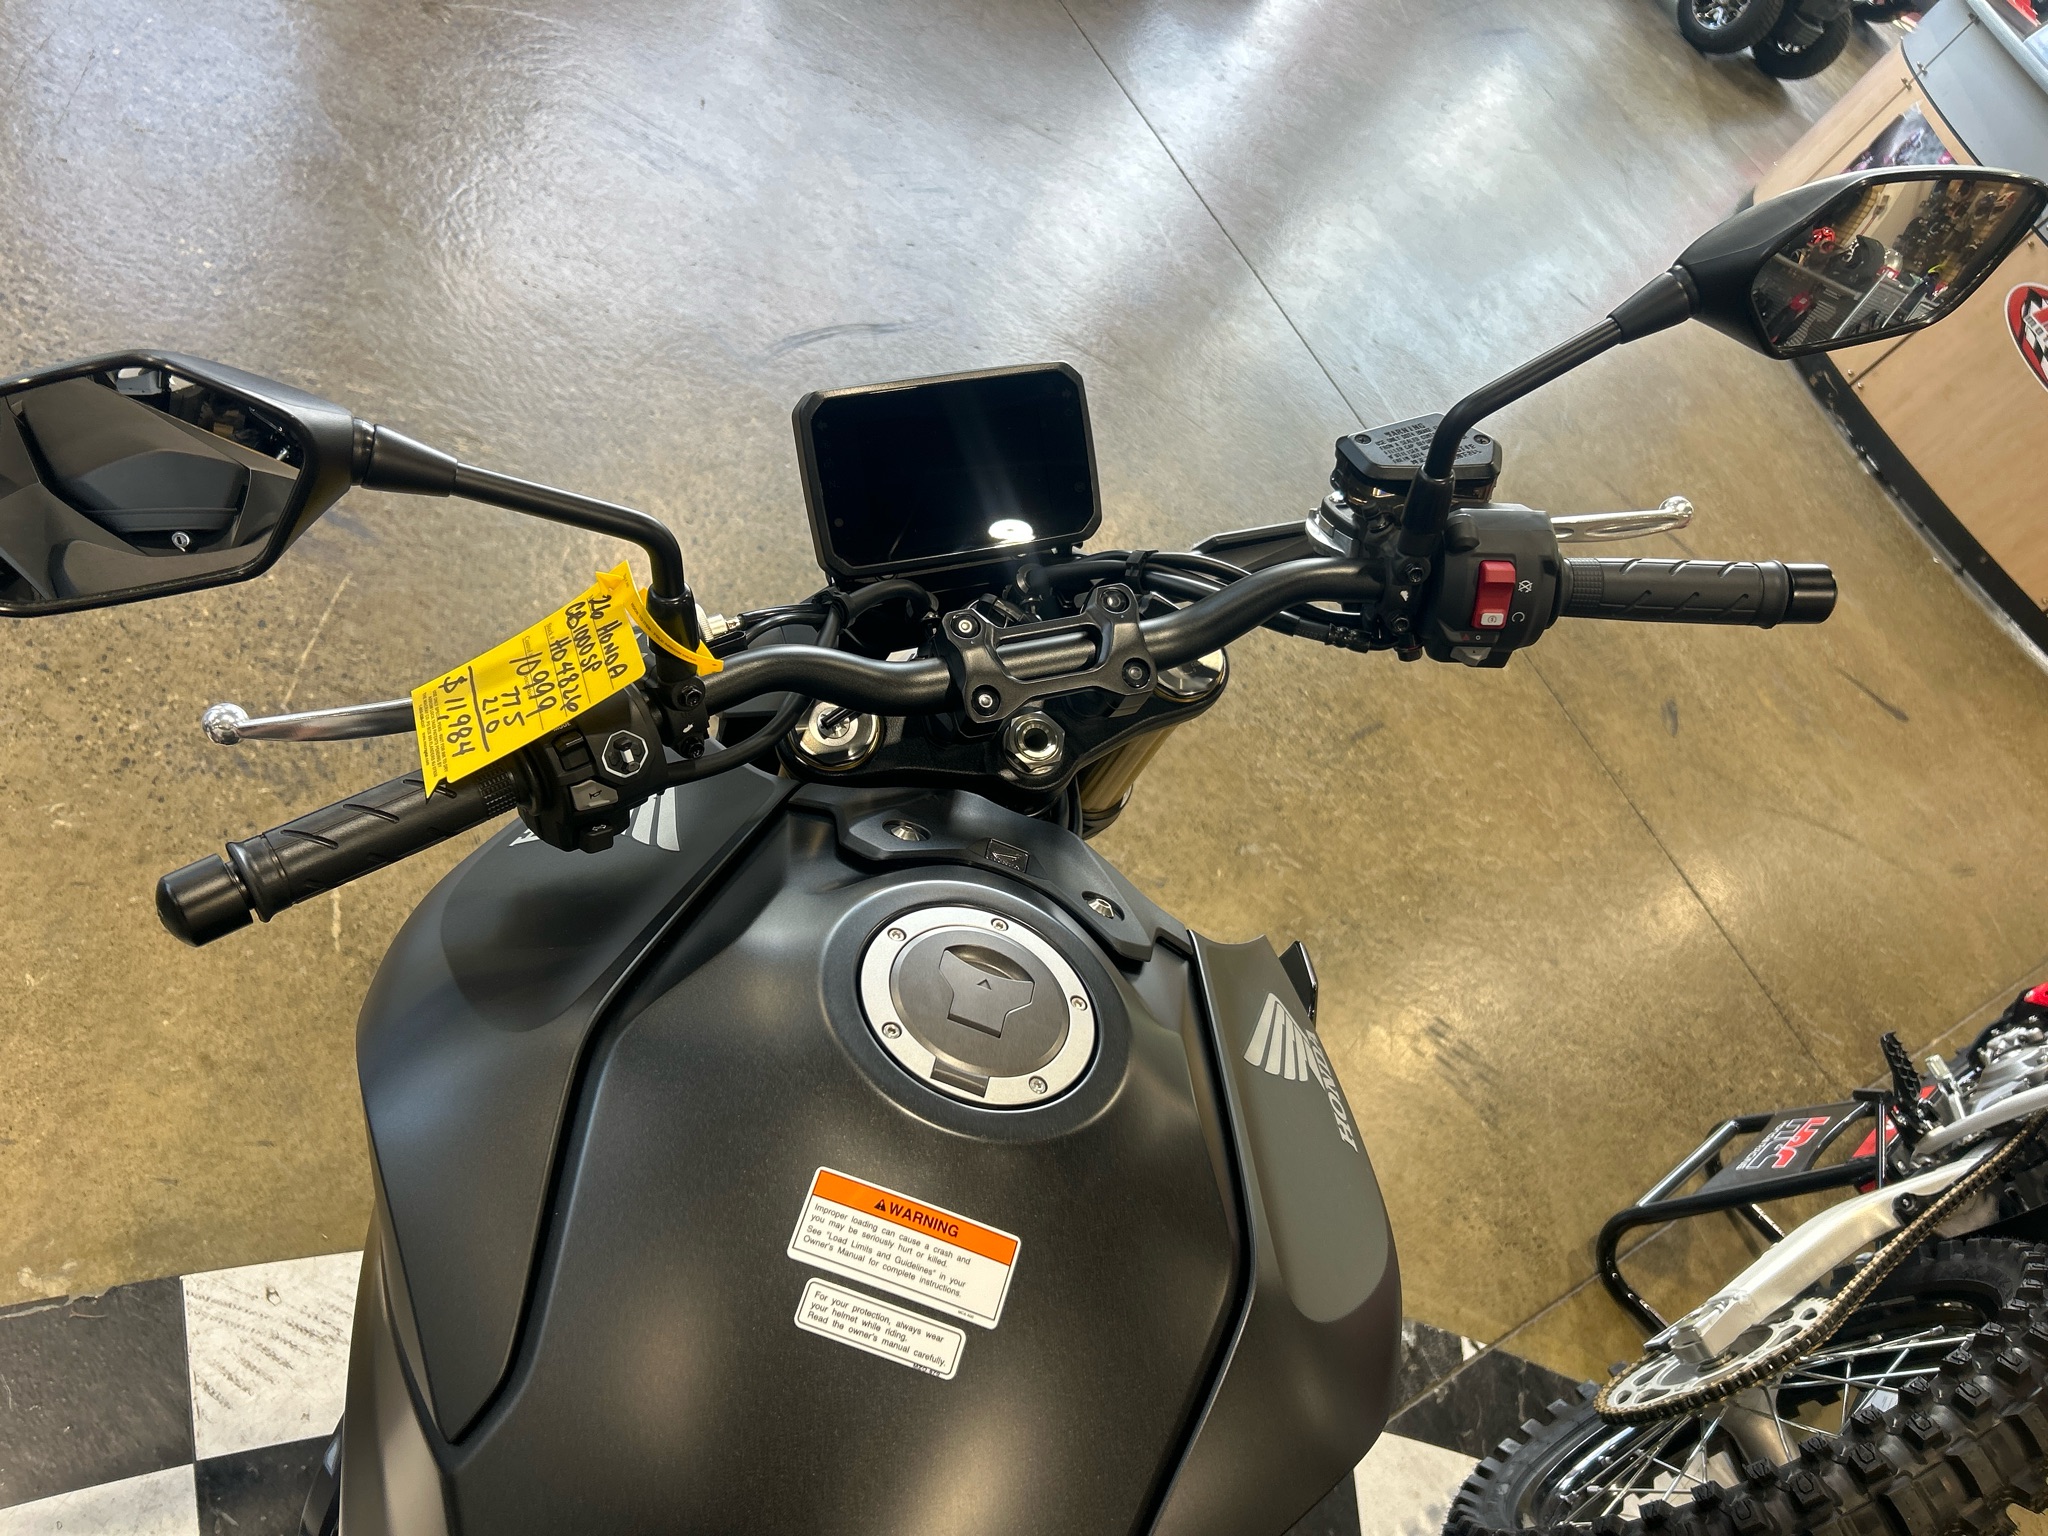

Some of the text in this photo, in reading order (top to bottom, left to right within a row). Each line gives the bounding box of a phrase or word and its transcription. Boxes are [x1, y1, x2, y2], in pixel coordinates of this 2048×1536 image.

[597, 620, 628, 680] HONDA
[509, 652, 557, 717] 10999
[810, 1214, 948, 1268] you may be seriously hurt or killed.
[814, 1203, 848, 1222] Improper
[851, 1216, 879, 1233] loading
[881, 1227, 895, 1238] can
[899, 1233, 921, 1247] cause
[933, 1245, 953, 1260] crash
[957, 1254, 971, 1265] and
[890, 1202, 960, 1238] WARNING
[803, 1235, 961, 1298] Owner's Manual for complete instructions.
[806, 1225, 822, 1236] See
[851, 1239, 873, 1254] Limits
[877, 1248, 891, 1261] and
[939, 1269, 946, 1280] in
[949, 1276, 966, 1289] your
[807, 1311, 946, 1367] Read the owner's manual carefully.
[810, 1301, 908, 1342] your helmet while riding.
[815, 1291, 944, 1343] For your protection, always wear
